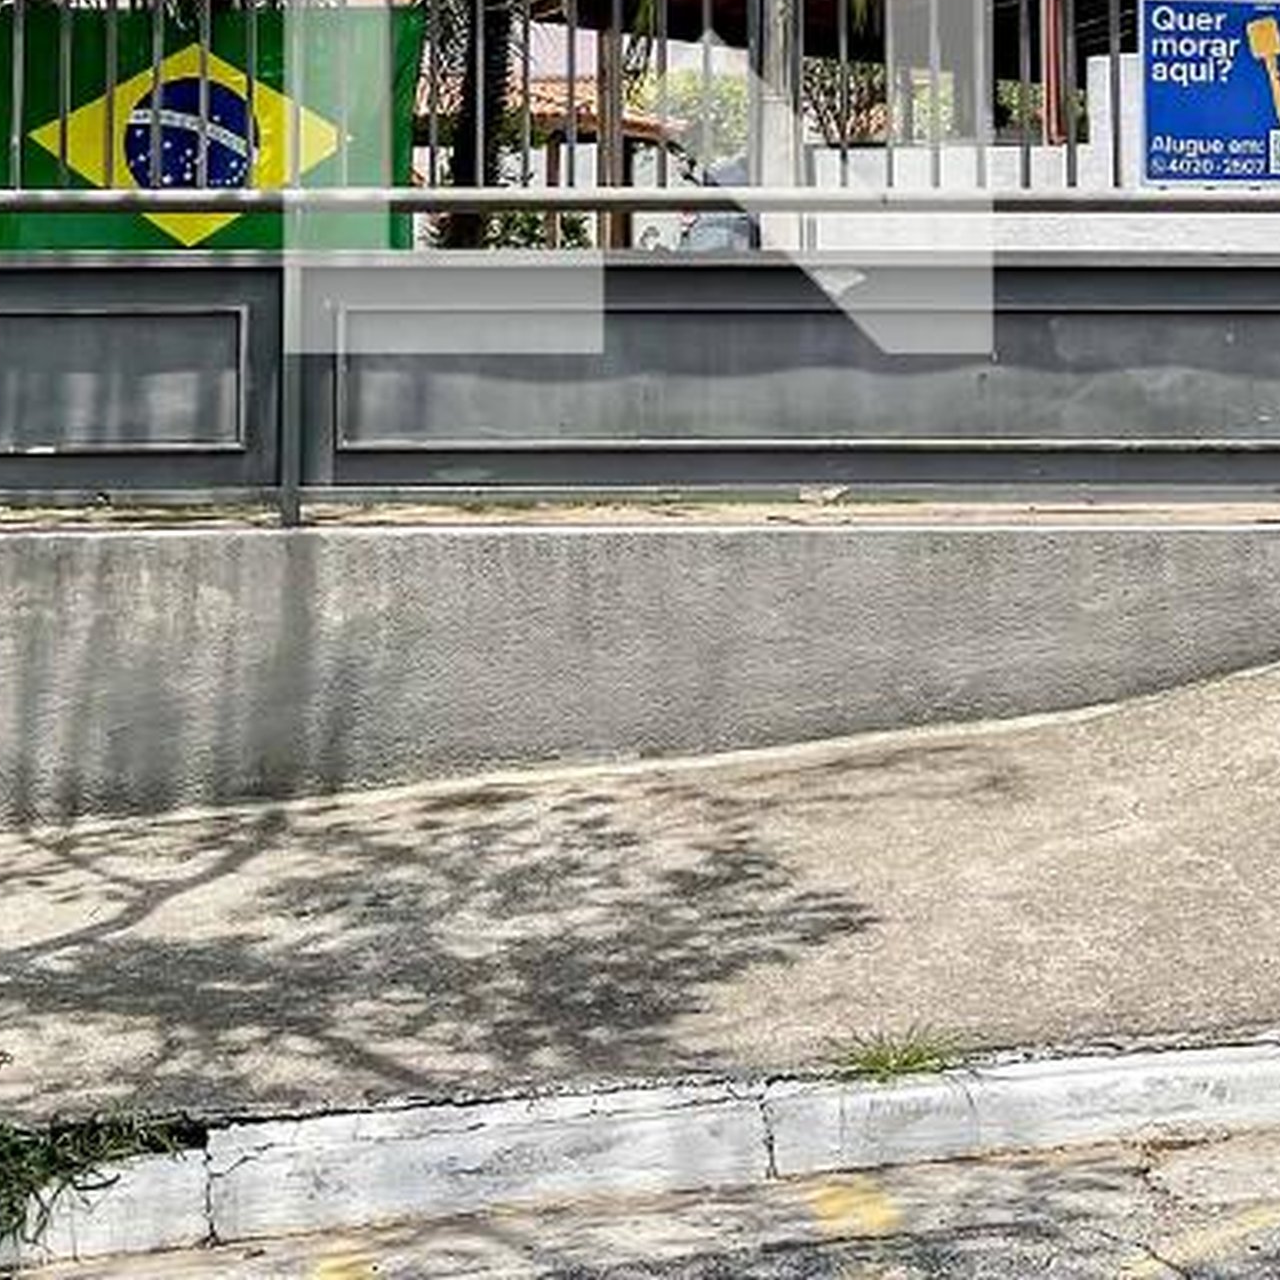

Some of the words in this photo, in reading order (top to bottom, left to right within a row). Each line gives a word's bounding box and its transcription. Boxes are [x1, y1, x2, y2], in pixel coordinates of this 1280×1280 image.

[1152, 6, 1227, 31] Quer
[1152, 36, 1241, 57] morar
[1152, 58, 1233, 86] aqui?
[1150, 135, 1224, 158] Alugue
